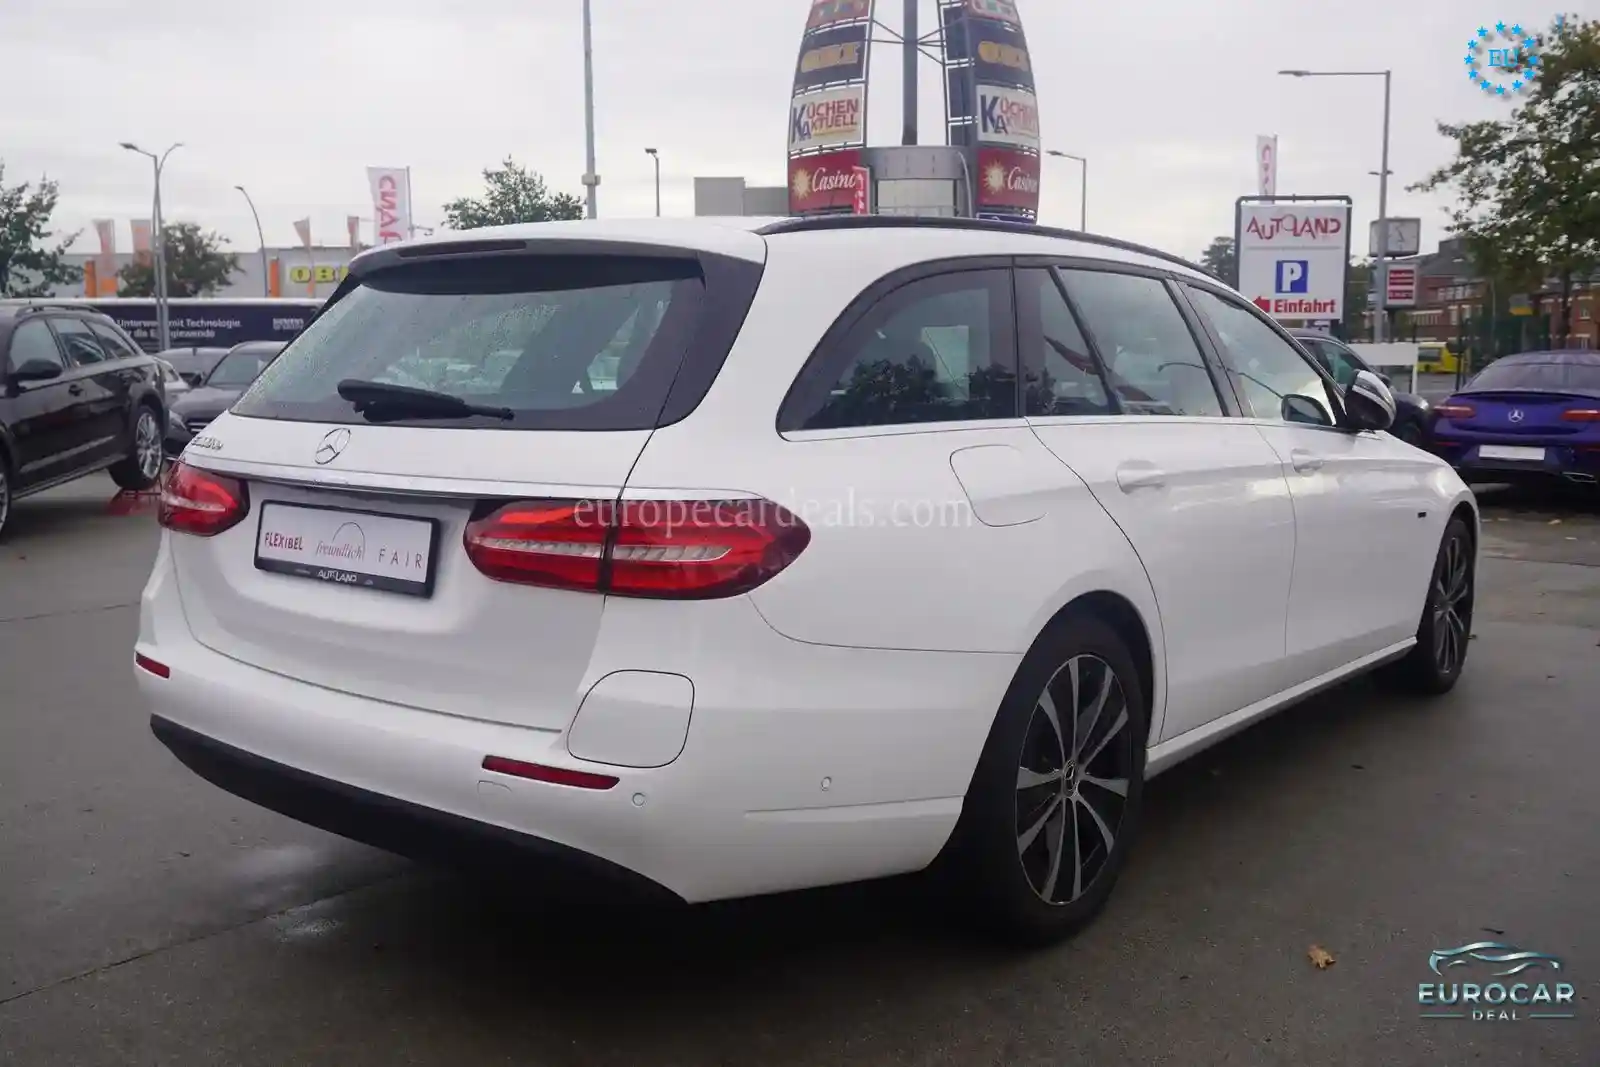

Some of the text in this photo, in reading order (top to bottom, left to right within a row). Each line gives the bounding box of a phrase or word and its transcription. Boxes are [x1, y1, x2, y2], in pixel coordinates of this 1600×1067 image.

[1007, 166, 1037, 193] Casin
[1246, 213, 1342, 240] AUTOLAND
[1282, 263, 1303, 292] P
[1274, 299, 1336, 313] Einfahrt
[117, 318, 158, 329] Unterwe
[264, 532, 304, 551] FLEXIBEL
[315, 540, 363, 562] freundlich
